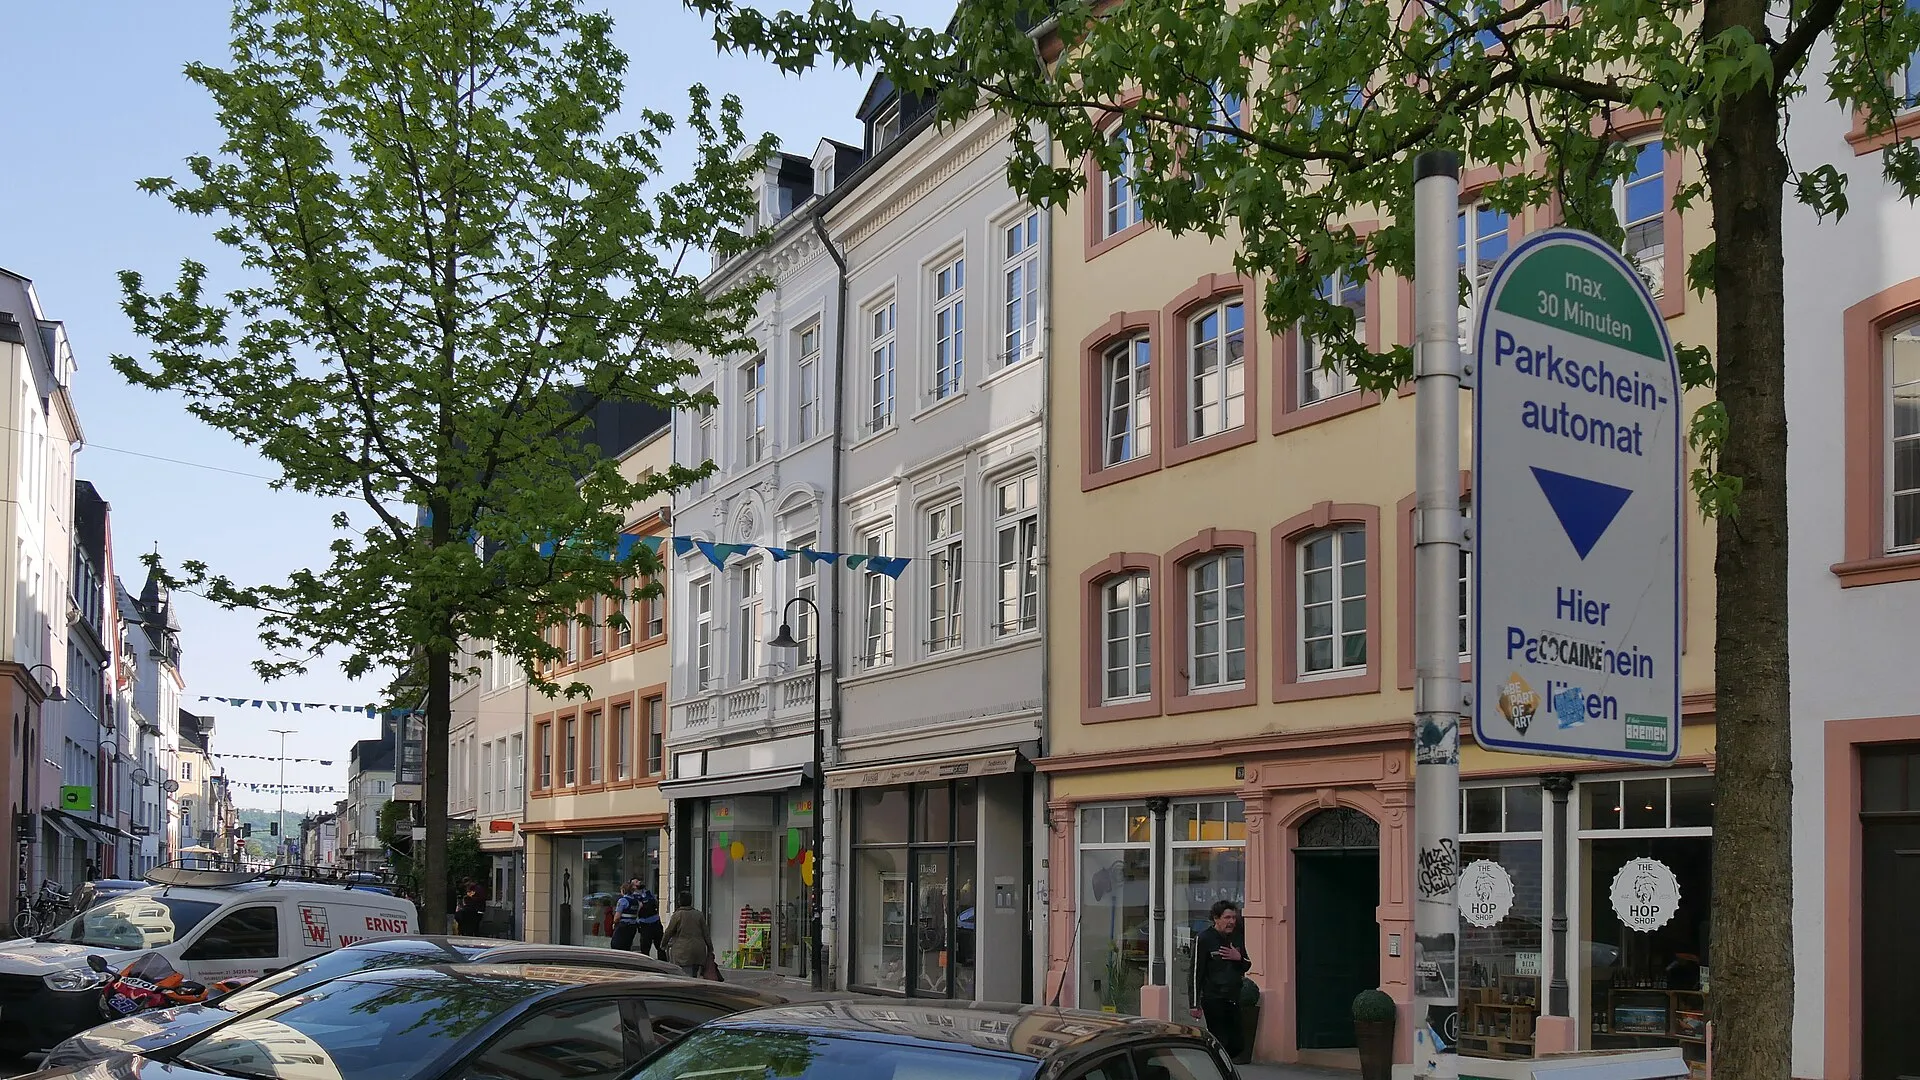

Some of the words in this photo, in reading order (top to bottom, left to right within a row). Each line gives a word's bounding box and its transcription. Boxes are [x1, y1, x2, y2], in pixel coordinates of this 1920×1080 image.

[1565, 271, 1606, 301] max.
[1538, 290, 1558, 317] 30
[1564, 298, 1632, 341] Minuten
[1495, 329, 1667, 410] Parkschein-
[1522, 400, 1642, 456] automat
[1556, 586, 1610, 626] Hier
[1507, 626, 1654, 679] Pahein
[1538, 634, 1603, 671] COCAINE
[1510, 691, 1534, 706] PART
[1512, 705, 1525, 718] OF
[1514, 715, 1532, 728] ART
[1637, 863, 1654, 871] THE
[303, 909, 313, 924] E
[1471, 903, 1497, 914] HOP
[1629, 905, 1660, 917] HOP
[365, 916, 408, 933] ERNST
[1634, 917, 1656, 925] SHOP
[308, 925, 326, 942] W
